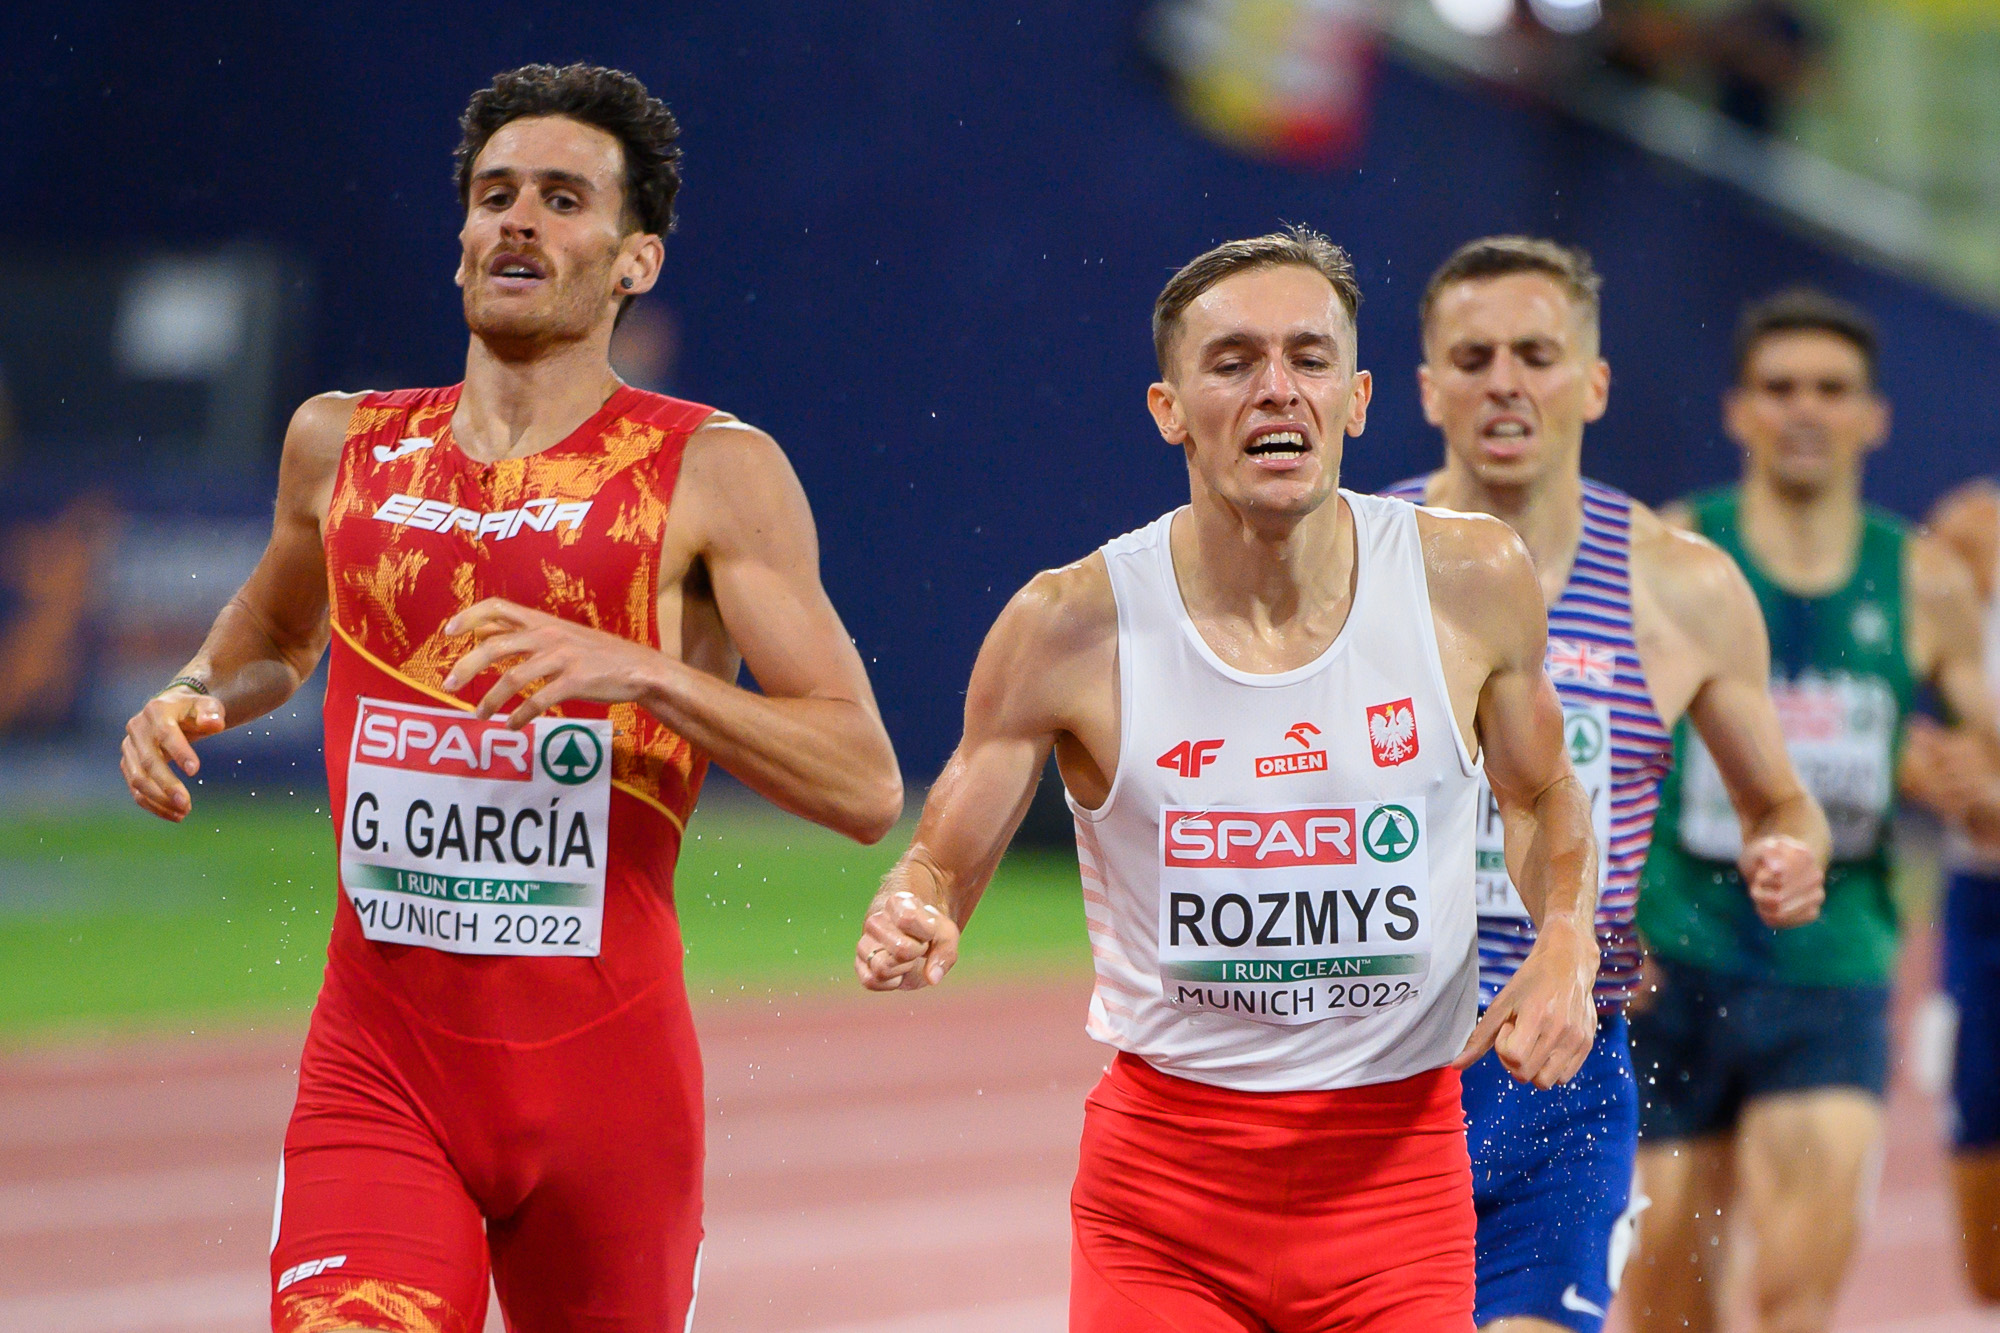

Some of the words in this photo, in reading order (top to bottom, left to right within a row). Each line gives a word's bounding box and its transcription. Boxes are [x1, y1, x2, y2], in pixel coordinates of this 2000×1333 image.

[372, 493, 594, 541] ESPAÑA
[360, 714, 530, 773] SPAR
[1156, 739, 1225, 778] 4F
[1258, 754, 1324, 775] ORLEN
[352, 792, 390, 853] G.
[404, 797, 596, 869] GARCÍA
[1170, 816, 1352, 861] SPAR
[397, 871, 403, 890] I
[408, 873, 448, 899] RUN
[353, 896, 479, 942] MUNICH
[494, 914, 582, 946] 2022
[1169, 885, 1420, 948] ROZMYS
[1221, 963, 1228, 980] I
[1235, 962, 1283, 981] RUN
[1177, 985, 1314, 1016] MUNICH
[1327, 981, 1412, 1010] 2022
[277, 1254, 348, 1293] ESP
